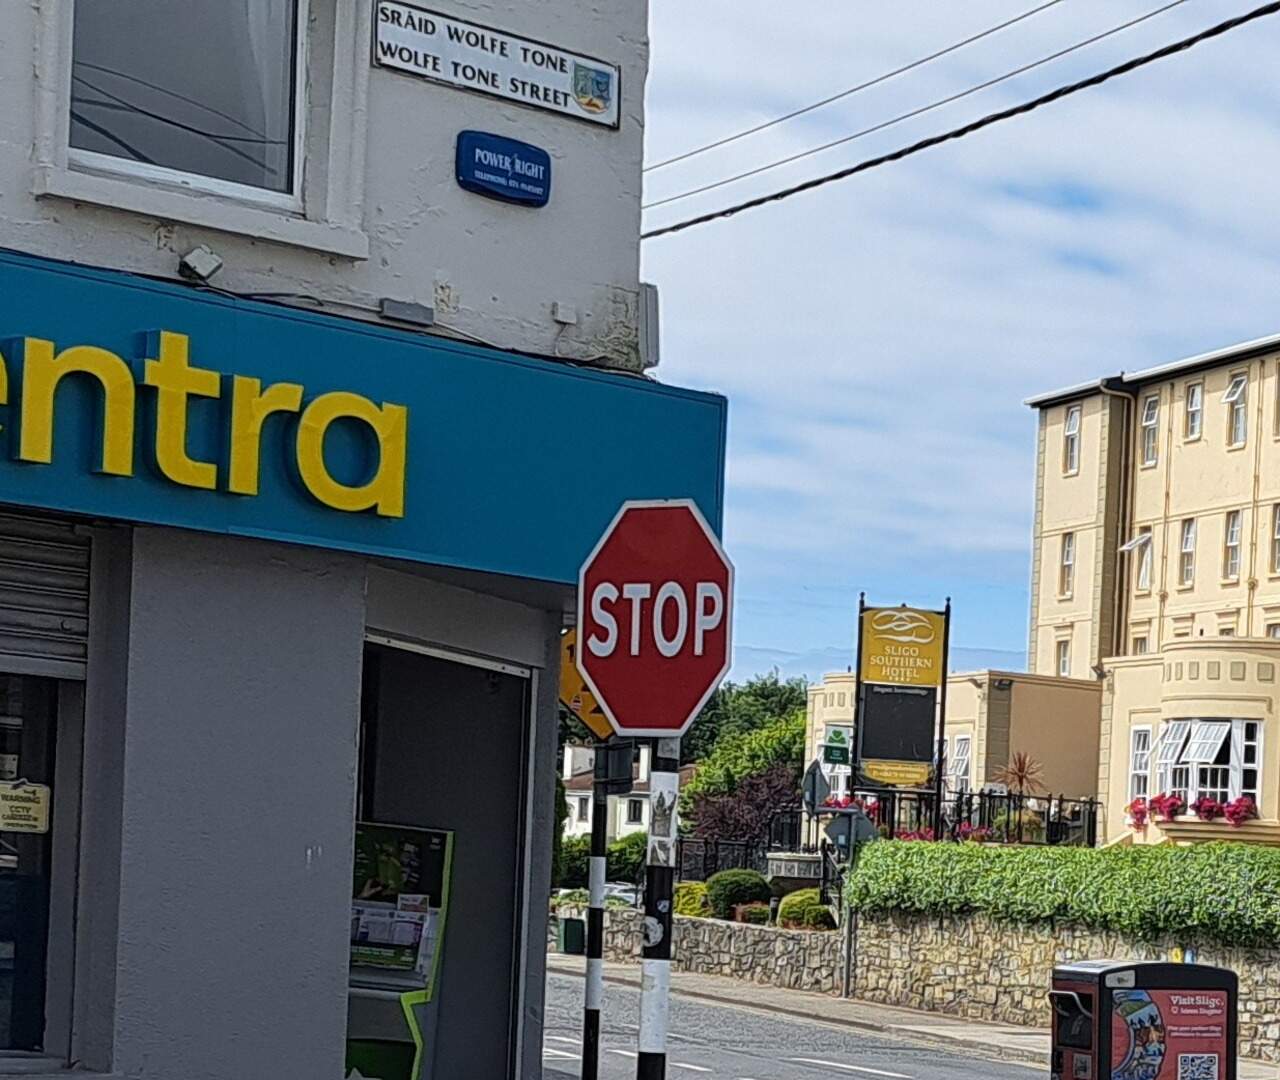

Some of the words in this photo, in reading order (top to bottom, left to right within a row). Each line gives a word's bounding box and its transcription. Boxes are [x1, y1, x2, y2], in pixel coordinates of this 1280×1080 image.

[380, 7, 436, 35] SRÁID
[446, 25, 509, 57] WOLFE
[520, 47, 568, 73] TONE
[379, 41, 441, 72] WOLFE
[451, 61, 499, 89] TONE
[509, 77, 571, 107] STREET
[475, 148, 511, 171] POWER
[515, 158, 544, 180] RIGHT
[587, 581, 723, 657] STOP
[870, 655, 932, 668] SOUTHERN
[884, 645, 919, 656] SLIGO
[881, 667, 920, 678] HOTEL
